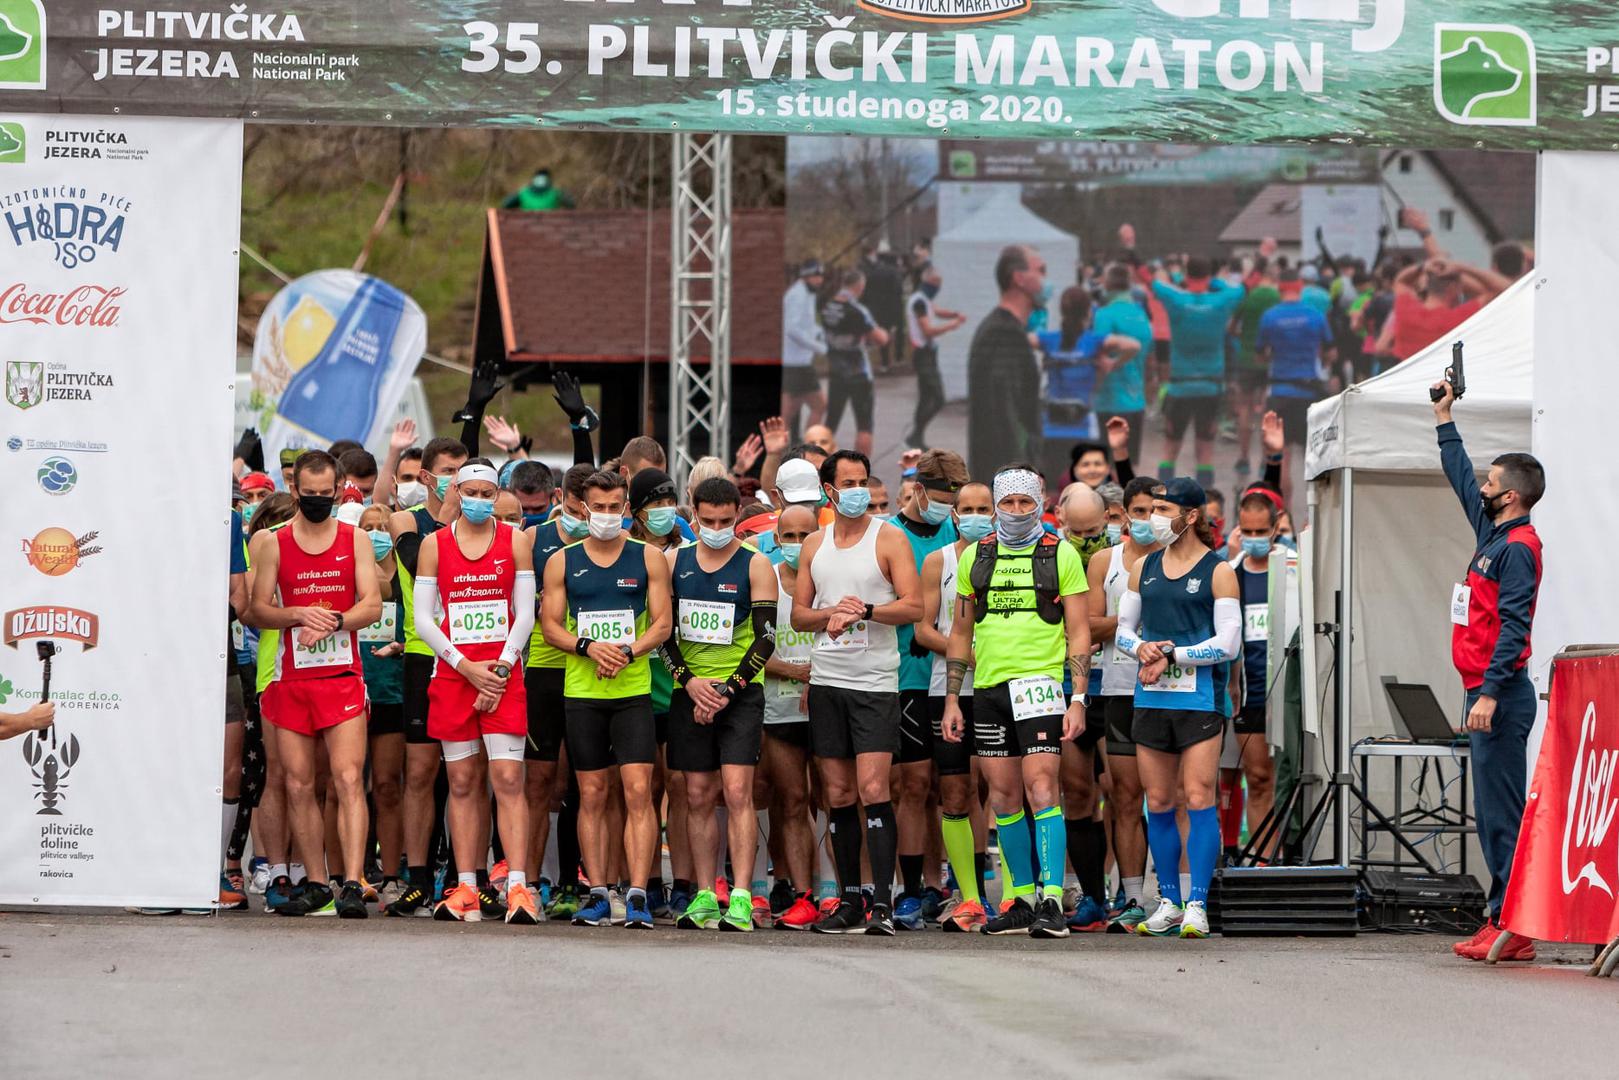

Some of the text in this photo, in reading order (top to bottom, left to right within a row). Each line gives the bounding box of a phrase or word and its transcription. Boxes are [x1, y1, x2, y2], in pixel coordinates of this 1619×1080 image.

[98, 3, 304, 41] PLITVIČKA
[252, 53, 359, 67] Nacionalni park
[461, 16, 1324, 92] 35. PLITVIČKI MARATON
[94, 48, 240, 81] JEZERA
[252, 68, 346, 81] National Park
[717, 89, 1073, 127] 15. studenoga 2020.
[46, 130, 127, 144] PLITVIČKA
[44, 147, 101, 159] JEZERA
[47, 372, 114, 386] PLITVIČKA
[46, 388, 92, 402] JEZERA
[21, 539, 75, 552] Natural
[297, 570, 340, 580] utrka.com
[454, 573, 497, 582] utrka.com
[316, 584, 345, 593] CROATIA
[473, 588, 503, 596] CROATIA
[13, 609, 91, 639] Ožujsko
[464, 612, 495, 631] 025
[691, 611, 719, 630] 088
[1249, 613, 1268, 629] 14
[591, 622, 622, 640] 085
[16, 688, 122, 702] Komnalac d.o.o.
[1025, 685, 1054, 704] 134
[60, 701, 120, 710] KORENICA
[41, 824, 94, 837] plitvičke
[41, 837, 79, 850] doline
[40, 852, 94, 861] plitvice valleys
[40, 869, 73, 879] rakovica
